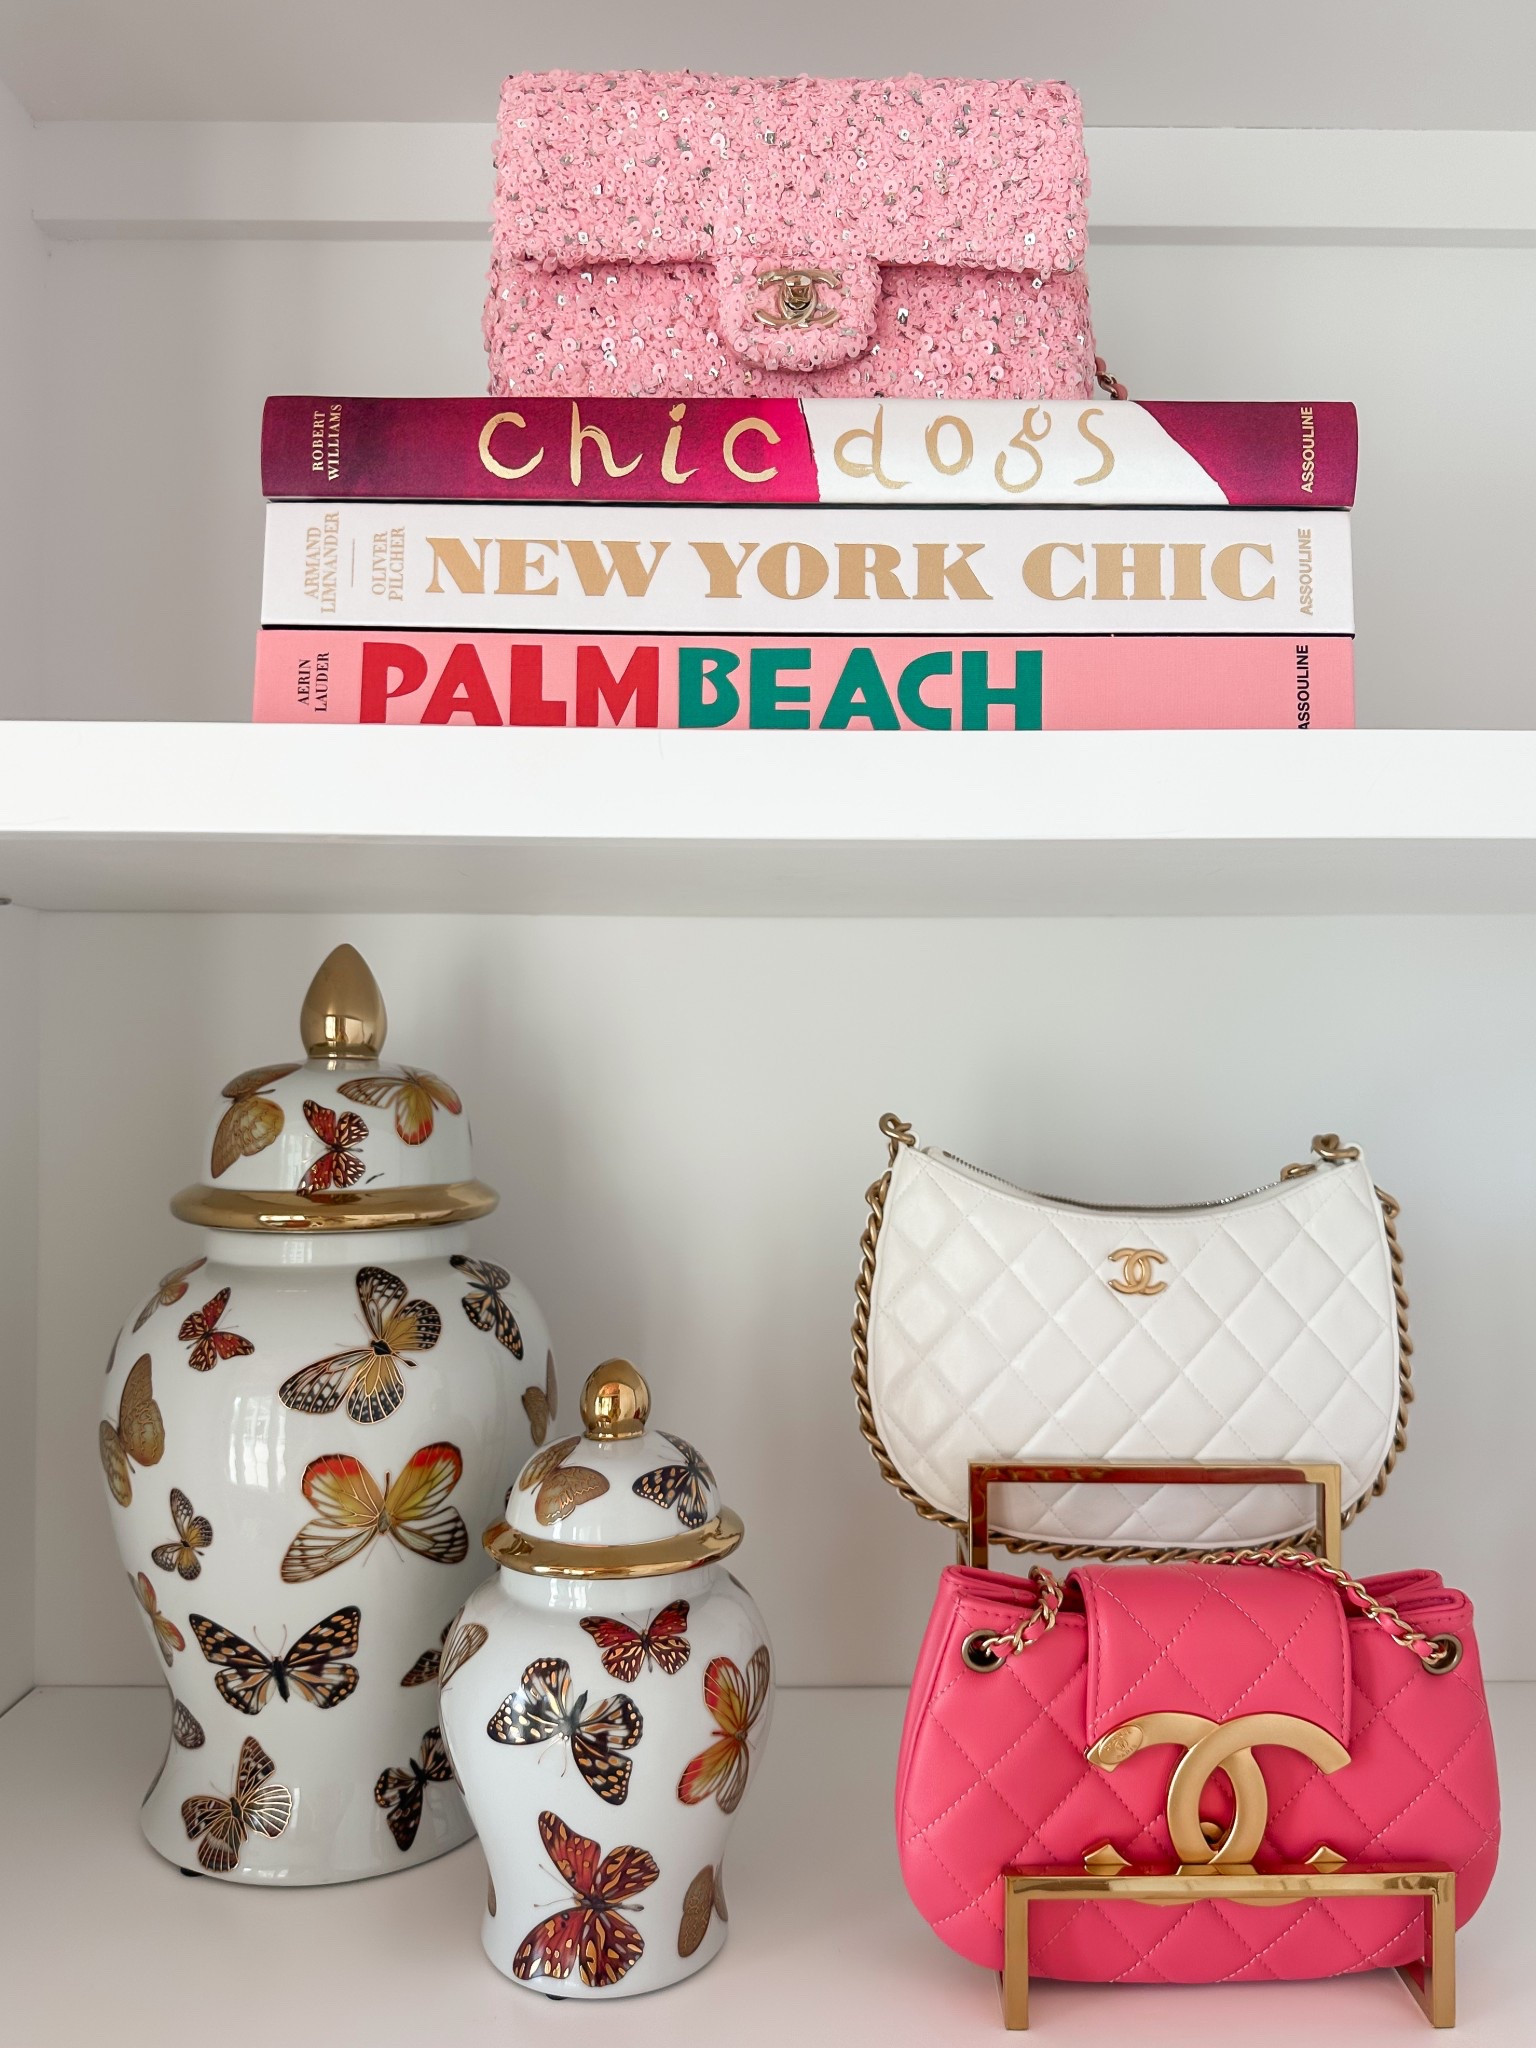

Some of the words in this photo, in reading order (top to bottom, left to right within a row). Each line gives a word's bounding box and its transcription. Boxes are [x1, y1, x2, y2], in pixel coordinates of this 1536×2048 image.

[311, 410, 326, 472] ROBERT
[327, 403, 343, 481] WILLIAMS
[1300, 406, 1316, 494] ASSOULINE
[303, 526, 322, 600] ARMAND
[320, 511, 340, 614] LIMNANDER
[371, 530, 388, 596] OLIVER
[388, 526, 405, 602] PILCHER
[424, 536, 671, 598] NEW
[688, 541, 993, 601] YORK
[1021, 542, 1276, 601] CHIC
[1297, 528, 1314, 616] ASSOULINE
[297, 658, 312, 706] AERIN
[314, 651, 330, 712] LAUDER
[359, 641, 660, 728] PALM
[678, 646, 1043, 731] BEACH
[1296, 644, 1311, 730] ASSOULINE
